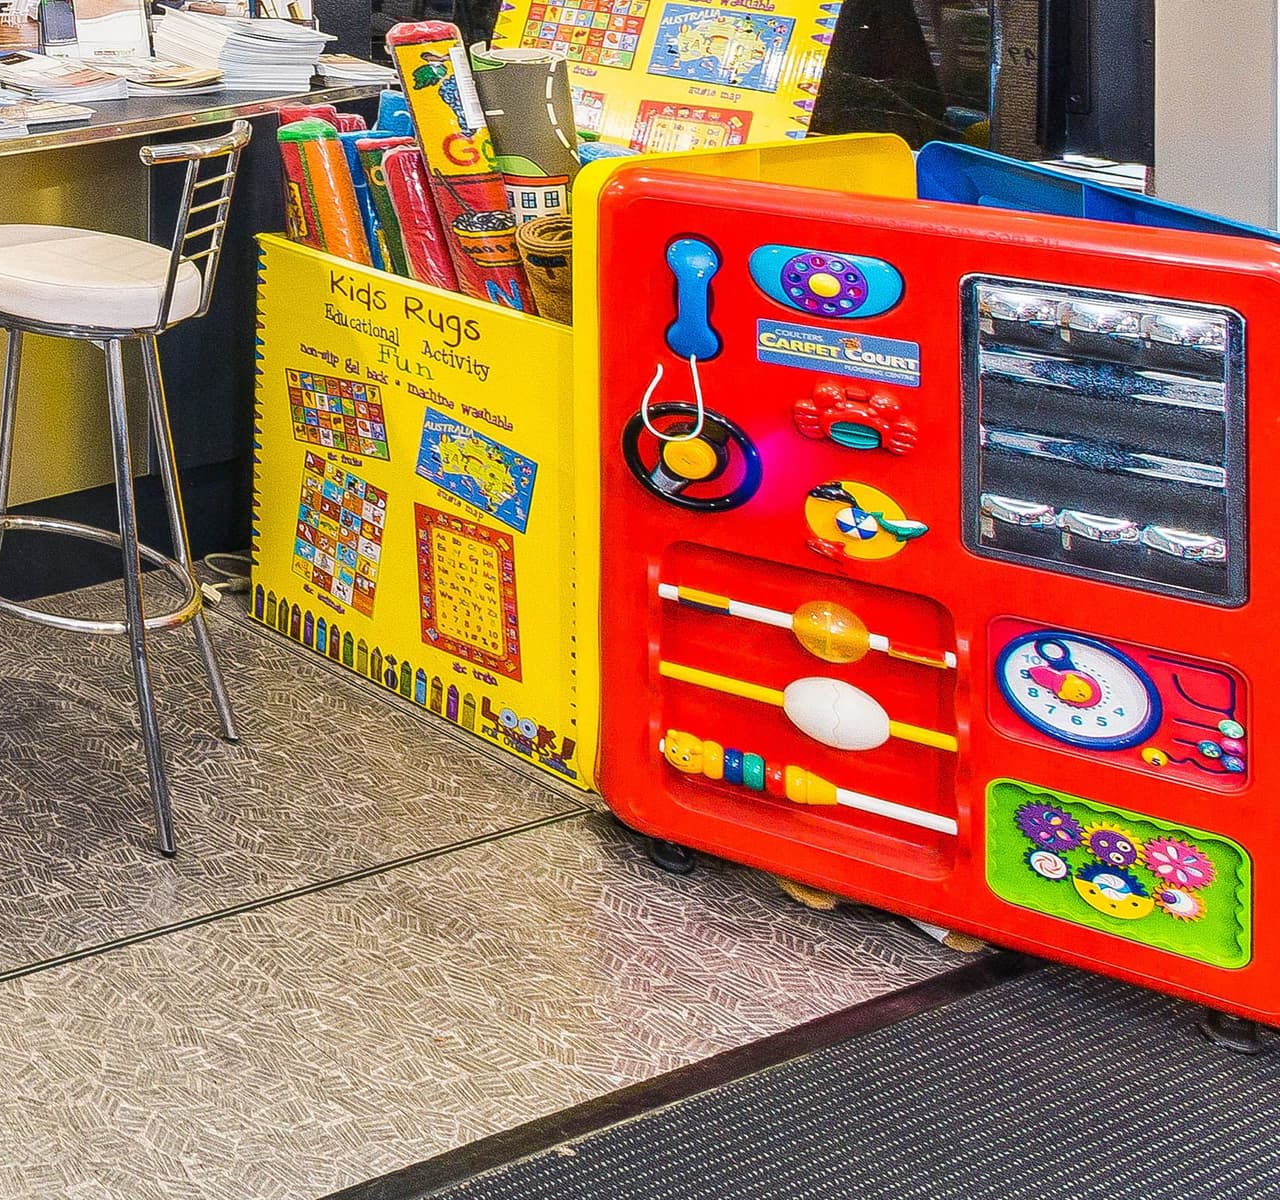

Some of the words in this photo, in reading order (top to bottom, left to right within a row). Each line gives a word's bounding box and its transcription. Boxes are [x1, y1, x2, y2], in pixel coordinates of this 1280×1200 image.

[661, 9, 721, 25] AUSTRALIA
[720, 90, 741, 103] map
[330, 270, 387, 311] Kids
[404, 296, 481, 348] Rugs
[324, 303, 400, 347] Educational
[775, 328, 824, 342] COULTERS
[759, 332, 840, 357] CARPET
[844, 349, 919, 370] COURT
[378, 344, 435, 380] Fun
[422, 340, 491, 382] Activity
[299, 343, 340, 368] non-slip
[344, 358, 360, 375] gel
[366, 366, 389, 385] back
[407, 382, 455, 409] machine
[461, 403, 514, 431] washable
[424, 420, 475, 439] AUSTRALIA
[466, 504, 484, 522] map
[1027, 687, 1040, 698] 8
[1045, 704, 1057, 715] 7
[1113, 707, 1125, 718] 4
[1071, 715, 1083, 726] 6
[1096, 716, 1108, 727] 5
